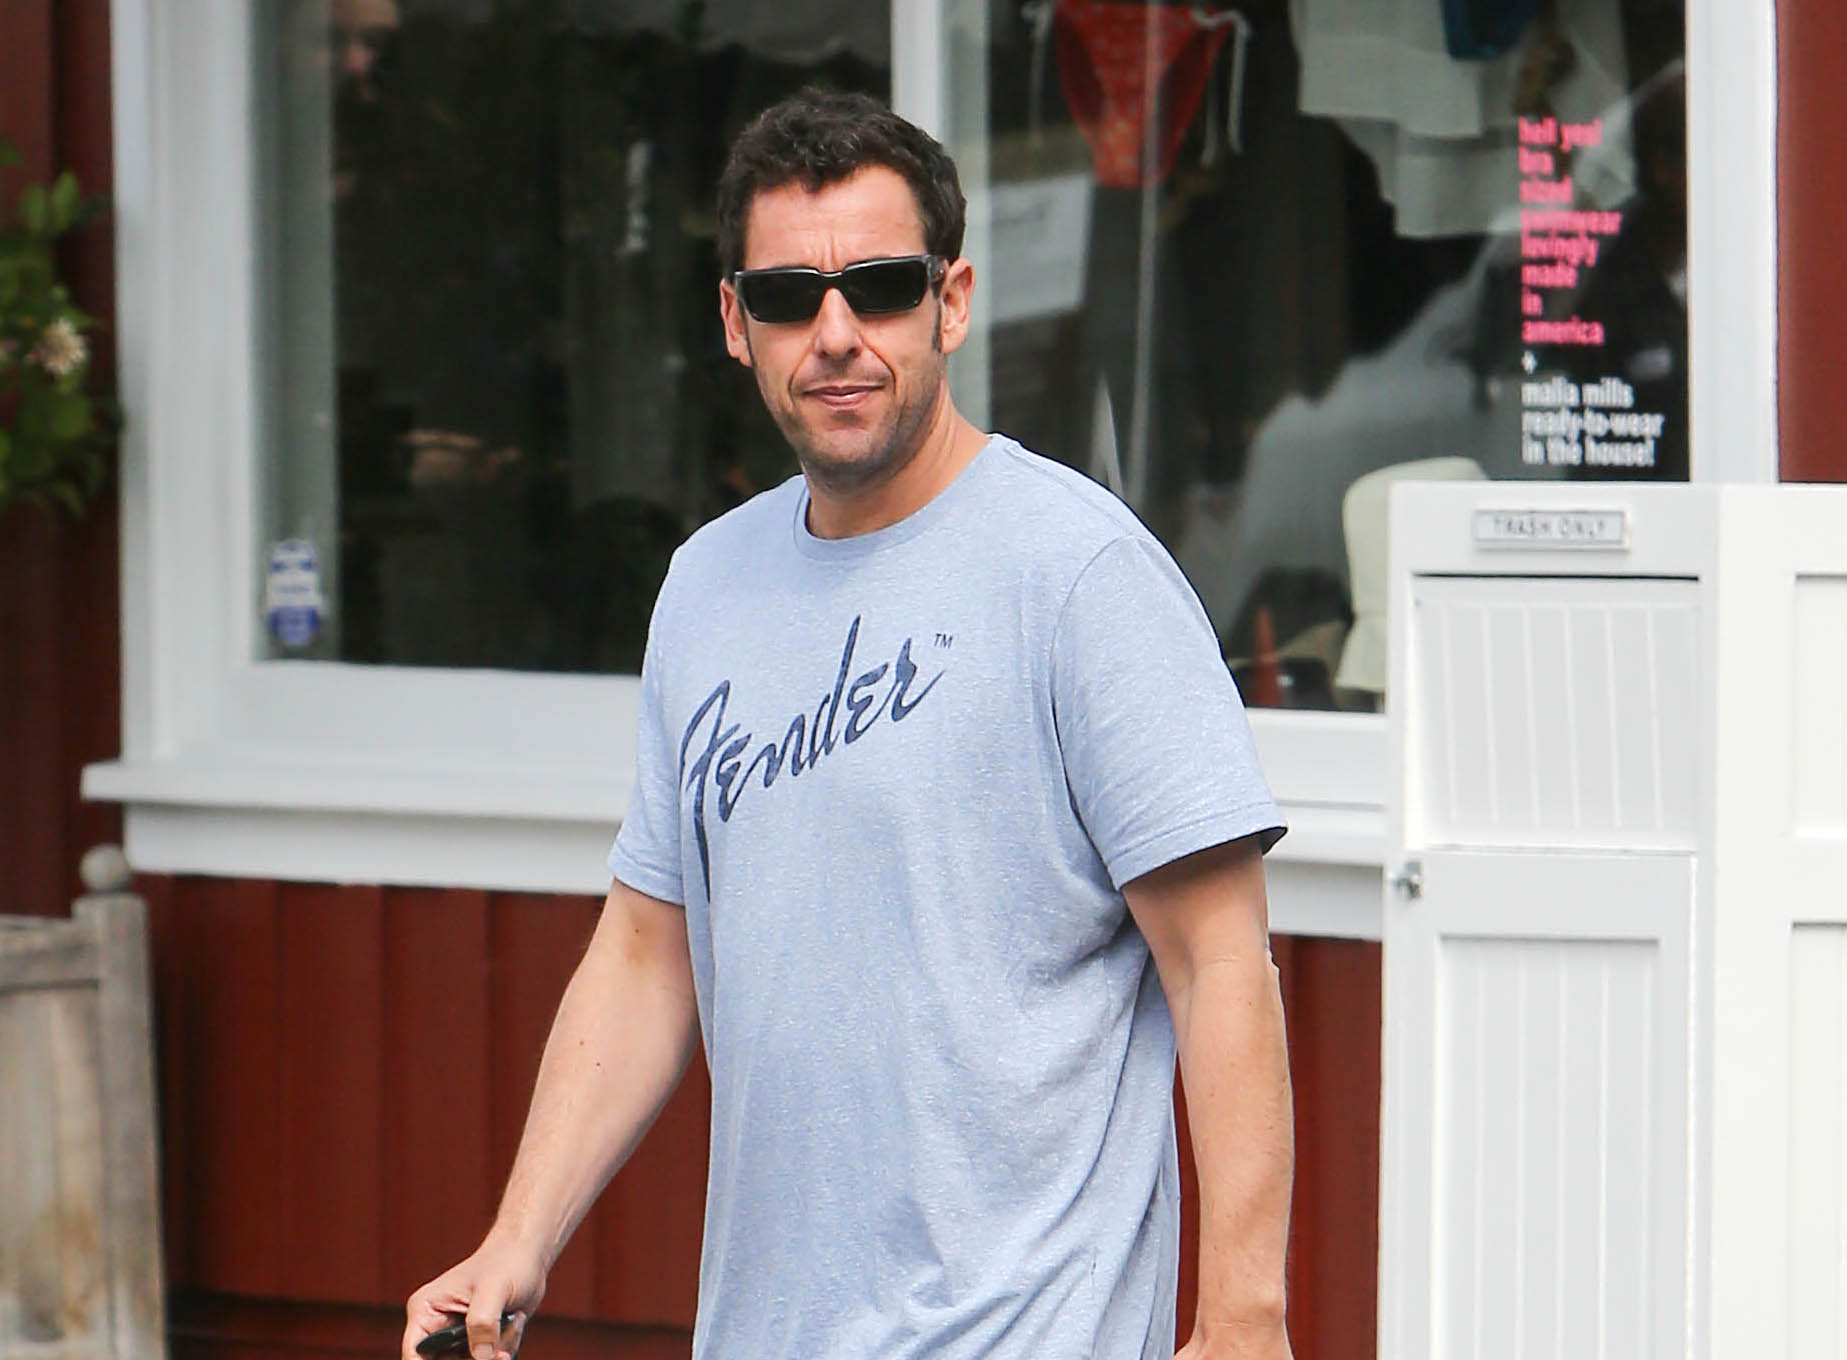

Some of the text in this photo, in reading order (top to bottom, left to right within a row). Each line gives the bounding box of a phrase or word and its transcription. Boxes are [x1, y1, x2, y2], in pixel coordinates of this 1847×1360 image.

[1522, 260, 1577, 288] made
[1522, 288, 1542, 316] in
[1522, 314, 1604, 345] america
[1582, 377, 1634, 408] mills
[1521, 406, 1665, 443] ready-to-wear
[1522, 434, 1655, 467] in the house!
[1493, 516, 1605, 537] TRASH ONLY
[679, 614, 945, 903] Fender
